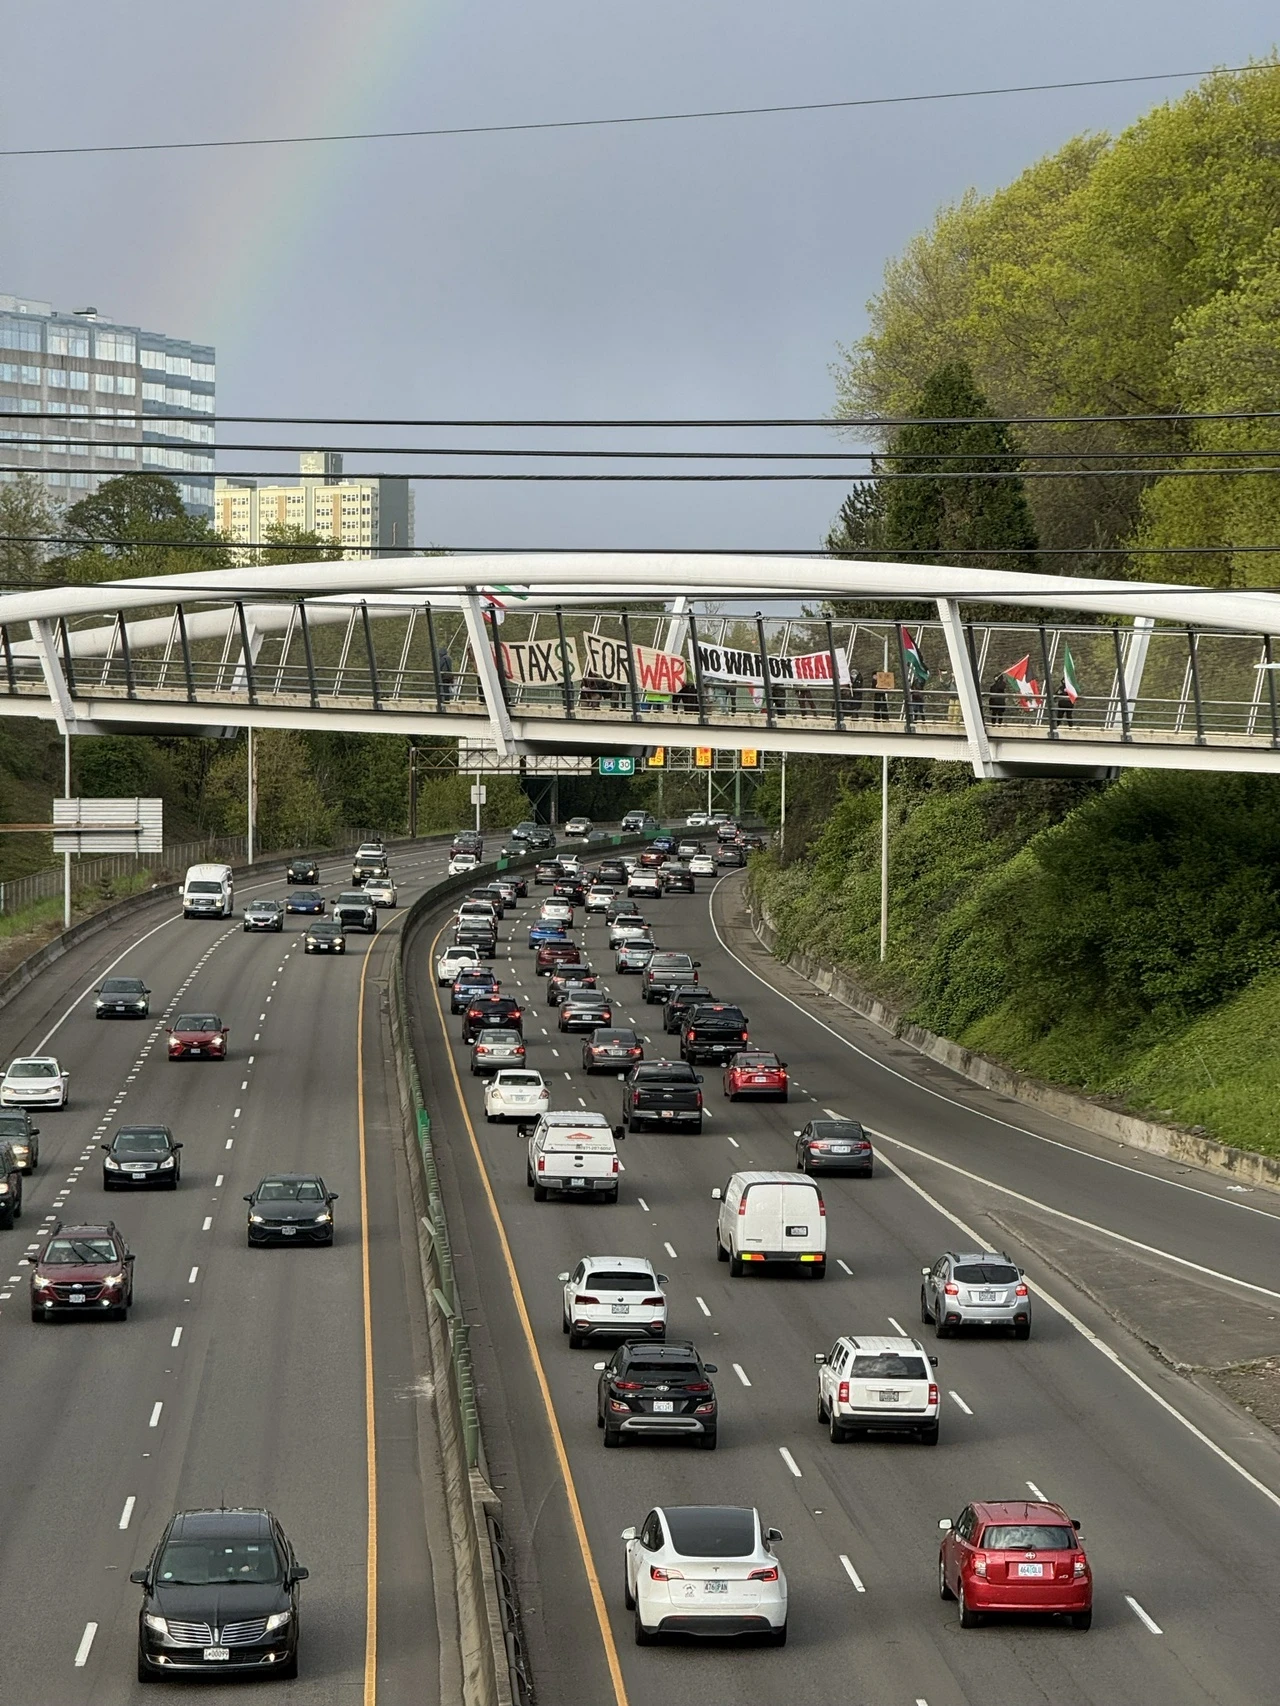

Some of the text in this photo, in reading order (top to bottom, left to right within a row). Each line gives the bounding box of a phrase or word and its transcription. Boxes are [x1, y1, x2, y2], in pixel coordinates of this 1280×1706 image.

[588, 636, 686, 692] FOR WAR
[698, 646, 721, 672] NO
[769, 658, 794, 678] ON
[698, 756, 709, 764] 45
